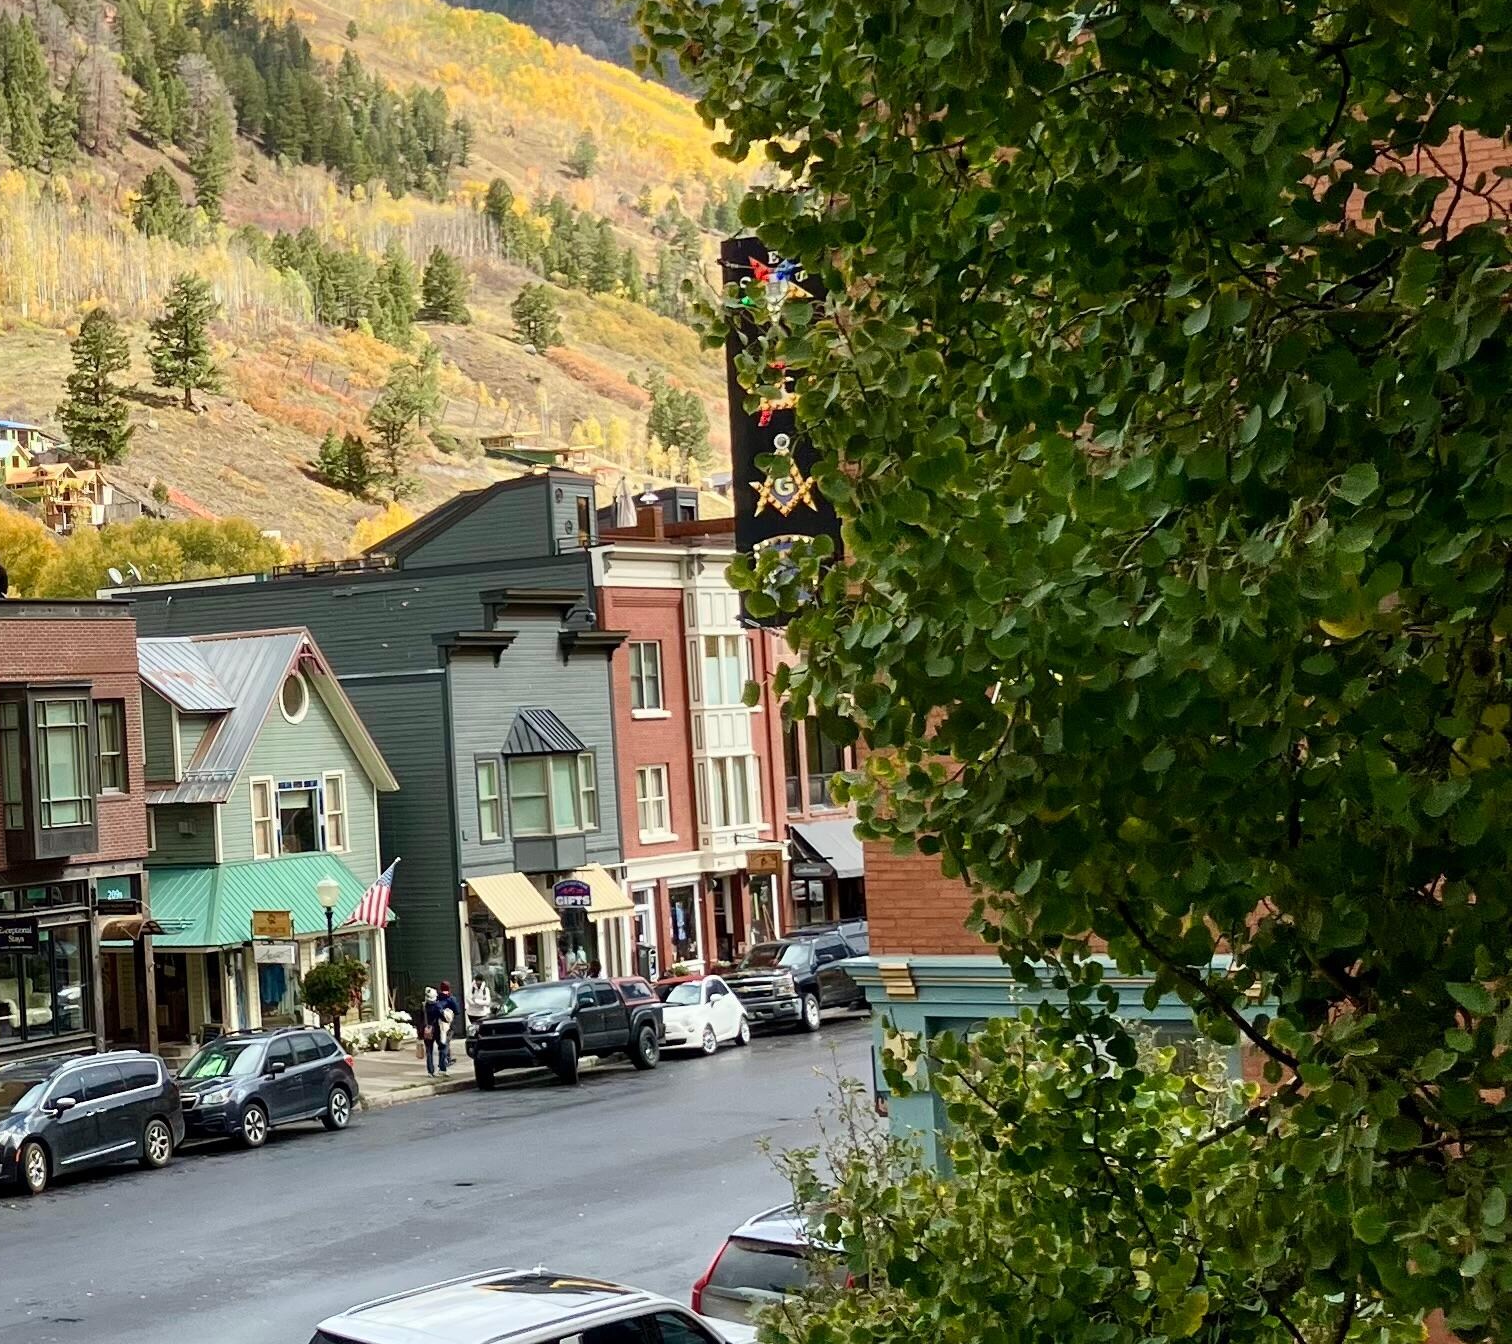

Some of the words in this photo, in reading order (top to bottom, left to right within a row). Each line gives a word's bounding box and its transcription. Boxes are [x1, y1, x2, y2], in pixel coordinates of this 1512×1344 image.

[768, 251, 779, 264] E
[775, 477, 795, 496] G
[556, 896, 590, 905] GIFTS
